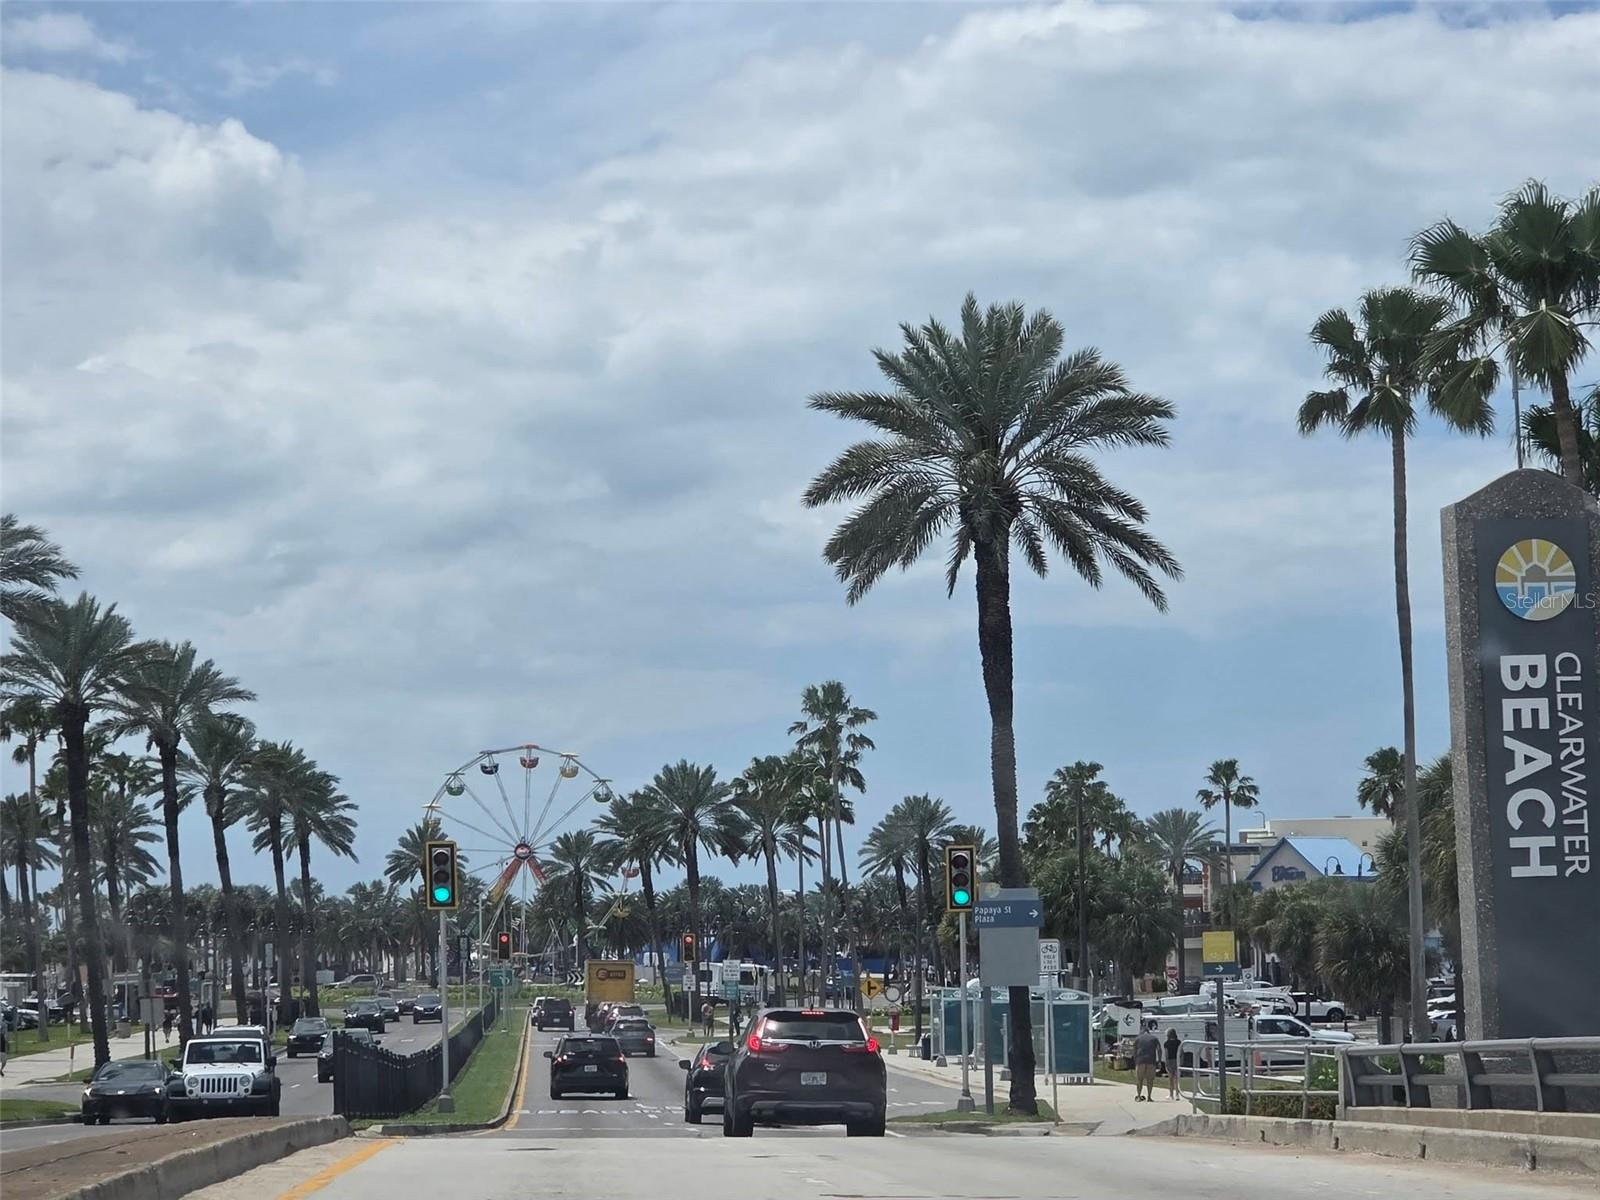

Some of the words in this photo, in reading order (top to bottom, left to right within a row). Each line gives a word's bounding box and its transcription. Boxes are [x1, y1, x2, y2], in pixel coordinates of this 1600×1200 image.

[1500, 654, 1558, 878] BEACH
[1554, 652, 1591, 878] CLEARWATER
[974, 906, 1002, 916] Papaya
[1003, 906, 1012, 914] St
[974, 915, 995, 924] Plaza
